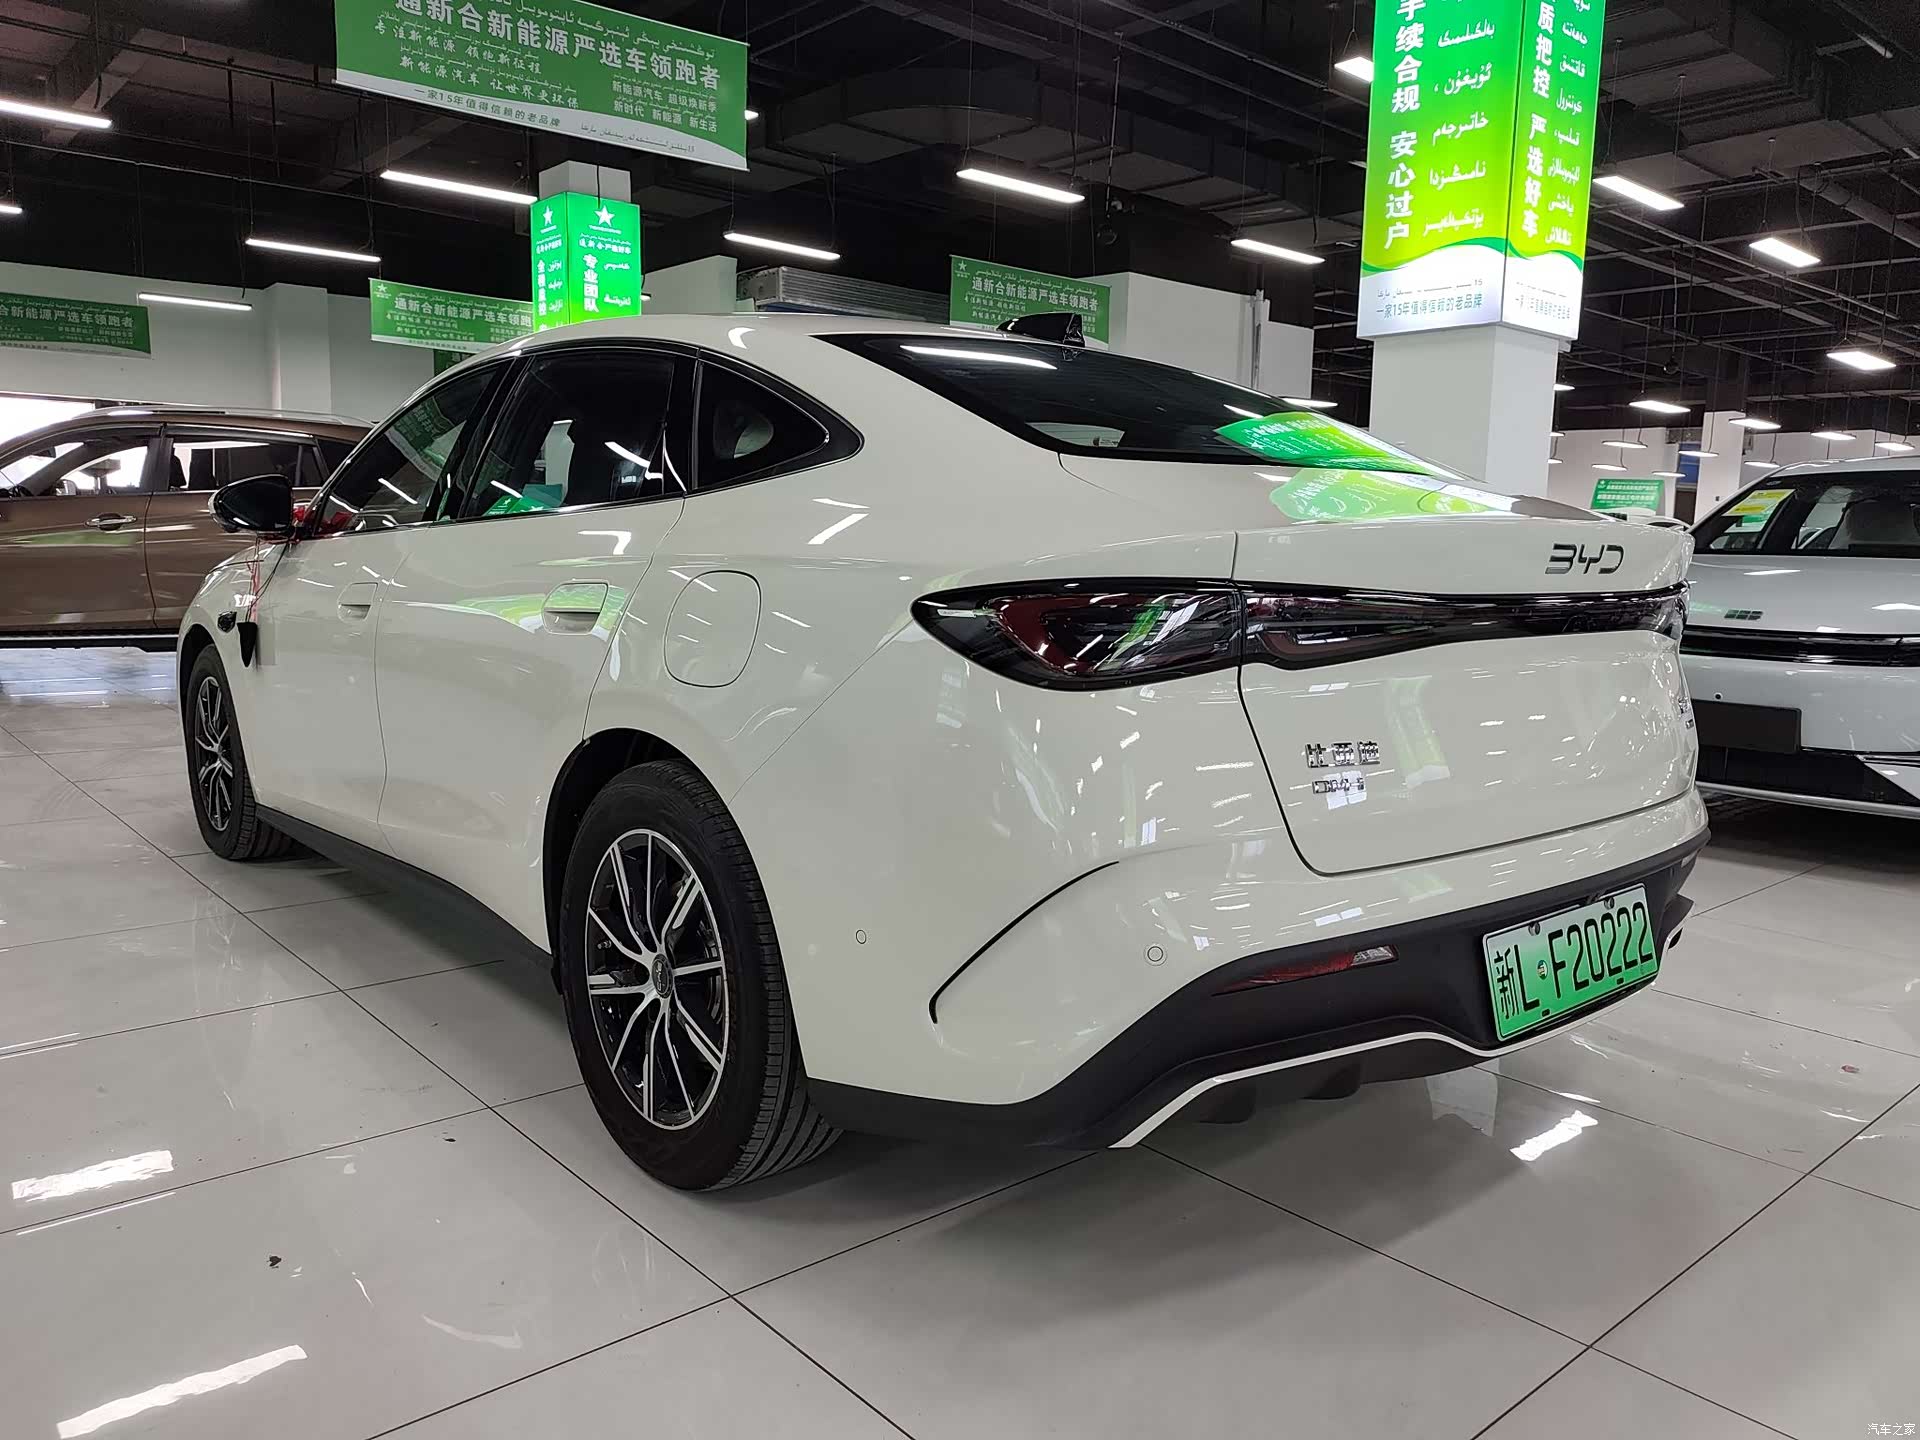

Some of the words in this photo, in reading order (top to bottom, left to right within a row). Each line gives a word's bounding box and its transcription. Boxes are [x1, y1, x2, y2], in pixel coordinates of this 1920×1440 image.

[400, 56, 480, 87] 新能源汽车
[612, 80, 663, 101] 新能源汽车
[613, 100, 645, 117] 新时代
[653, 109, 682, 124] 新能源
[689, 116, 718, 133] 新生活
[1384, 130, 1418, 249] 安心过户
[1522, 112, 1547, 238] 严选好车
[971, 276, 1099, 312] 通新合新能源严选车领跑者
[394, 297, 533, 327] 通新合新能源严选车领跑
[1545, 543, 1625, 574] BYD
